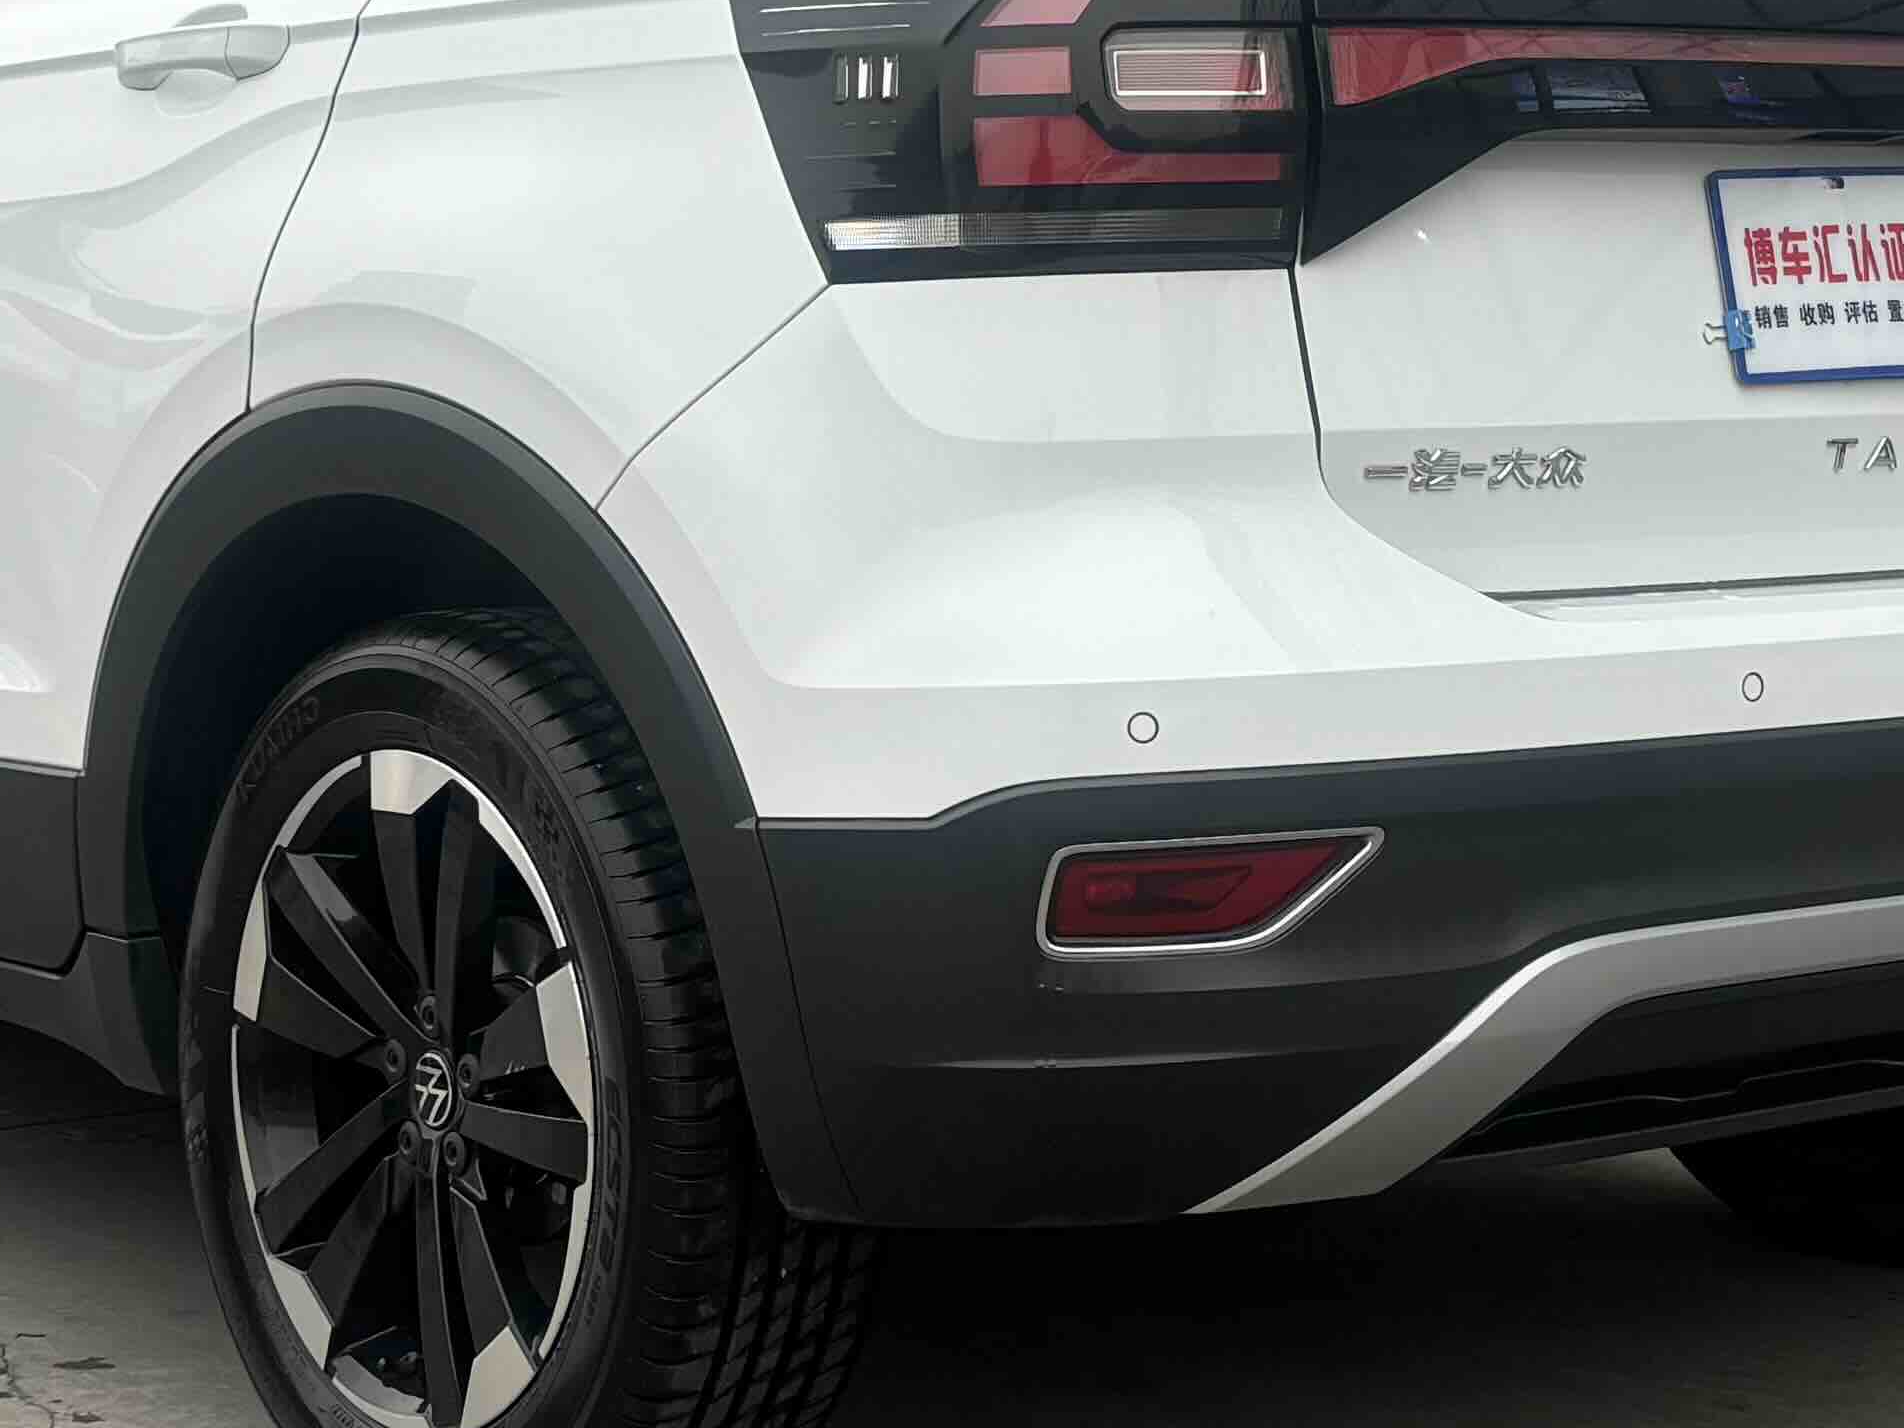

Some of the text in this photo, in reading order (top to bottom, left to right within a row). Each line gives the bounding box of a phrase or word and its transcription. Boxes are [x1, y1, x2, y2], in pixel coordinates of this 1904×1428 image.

[1754, 305, 1790, 330] 销售
[1799, 303, 1836, 327] 收购
[1844, 301, 1879, 325] 评估
